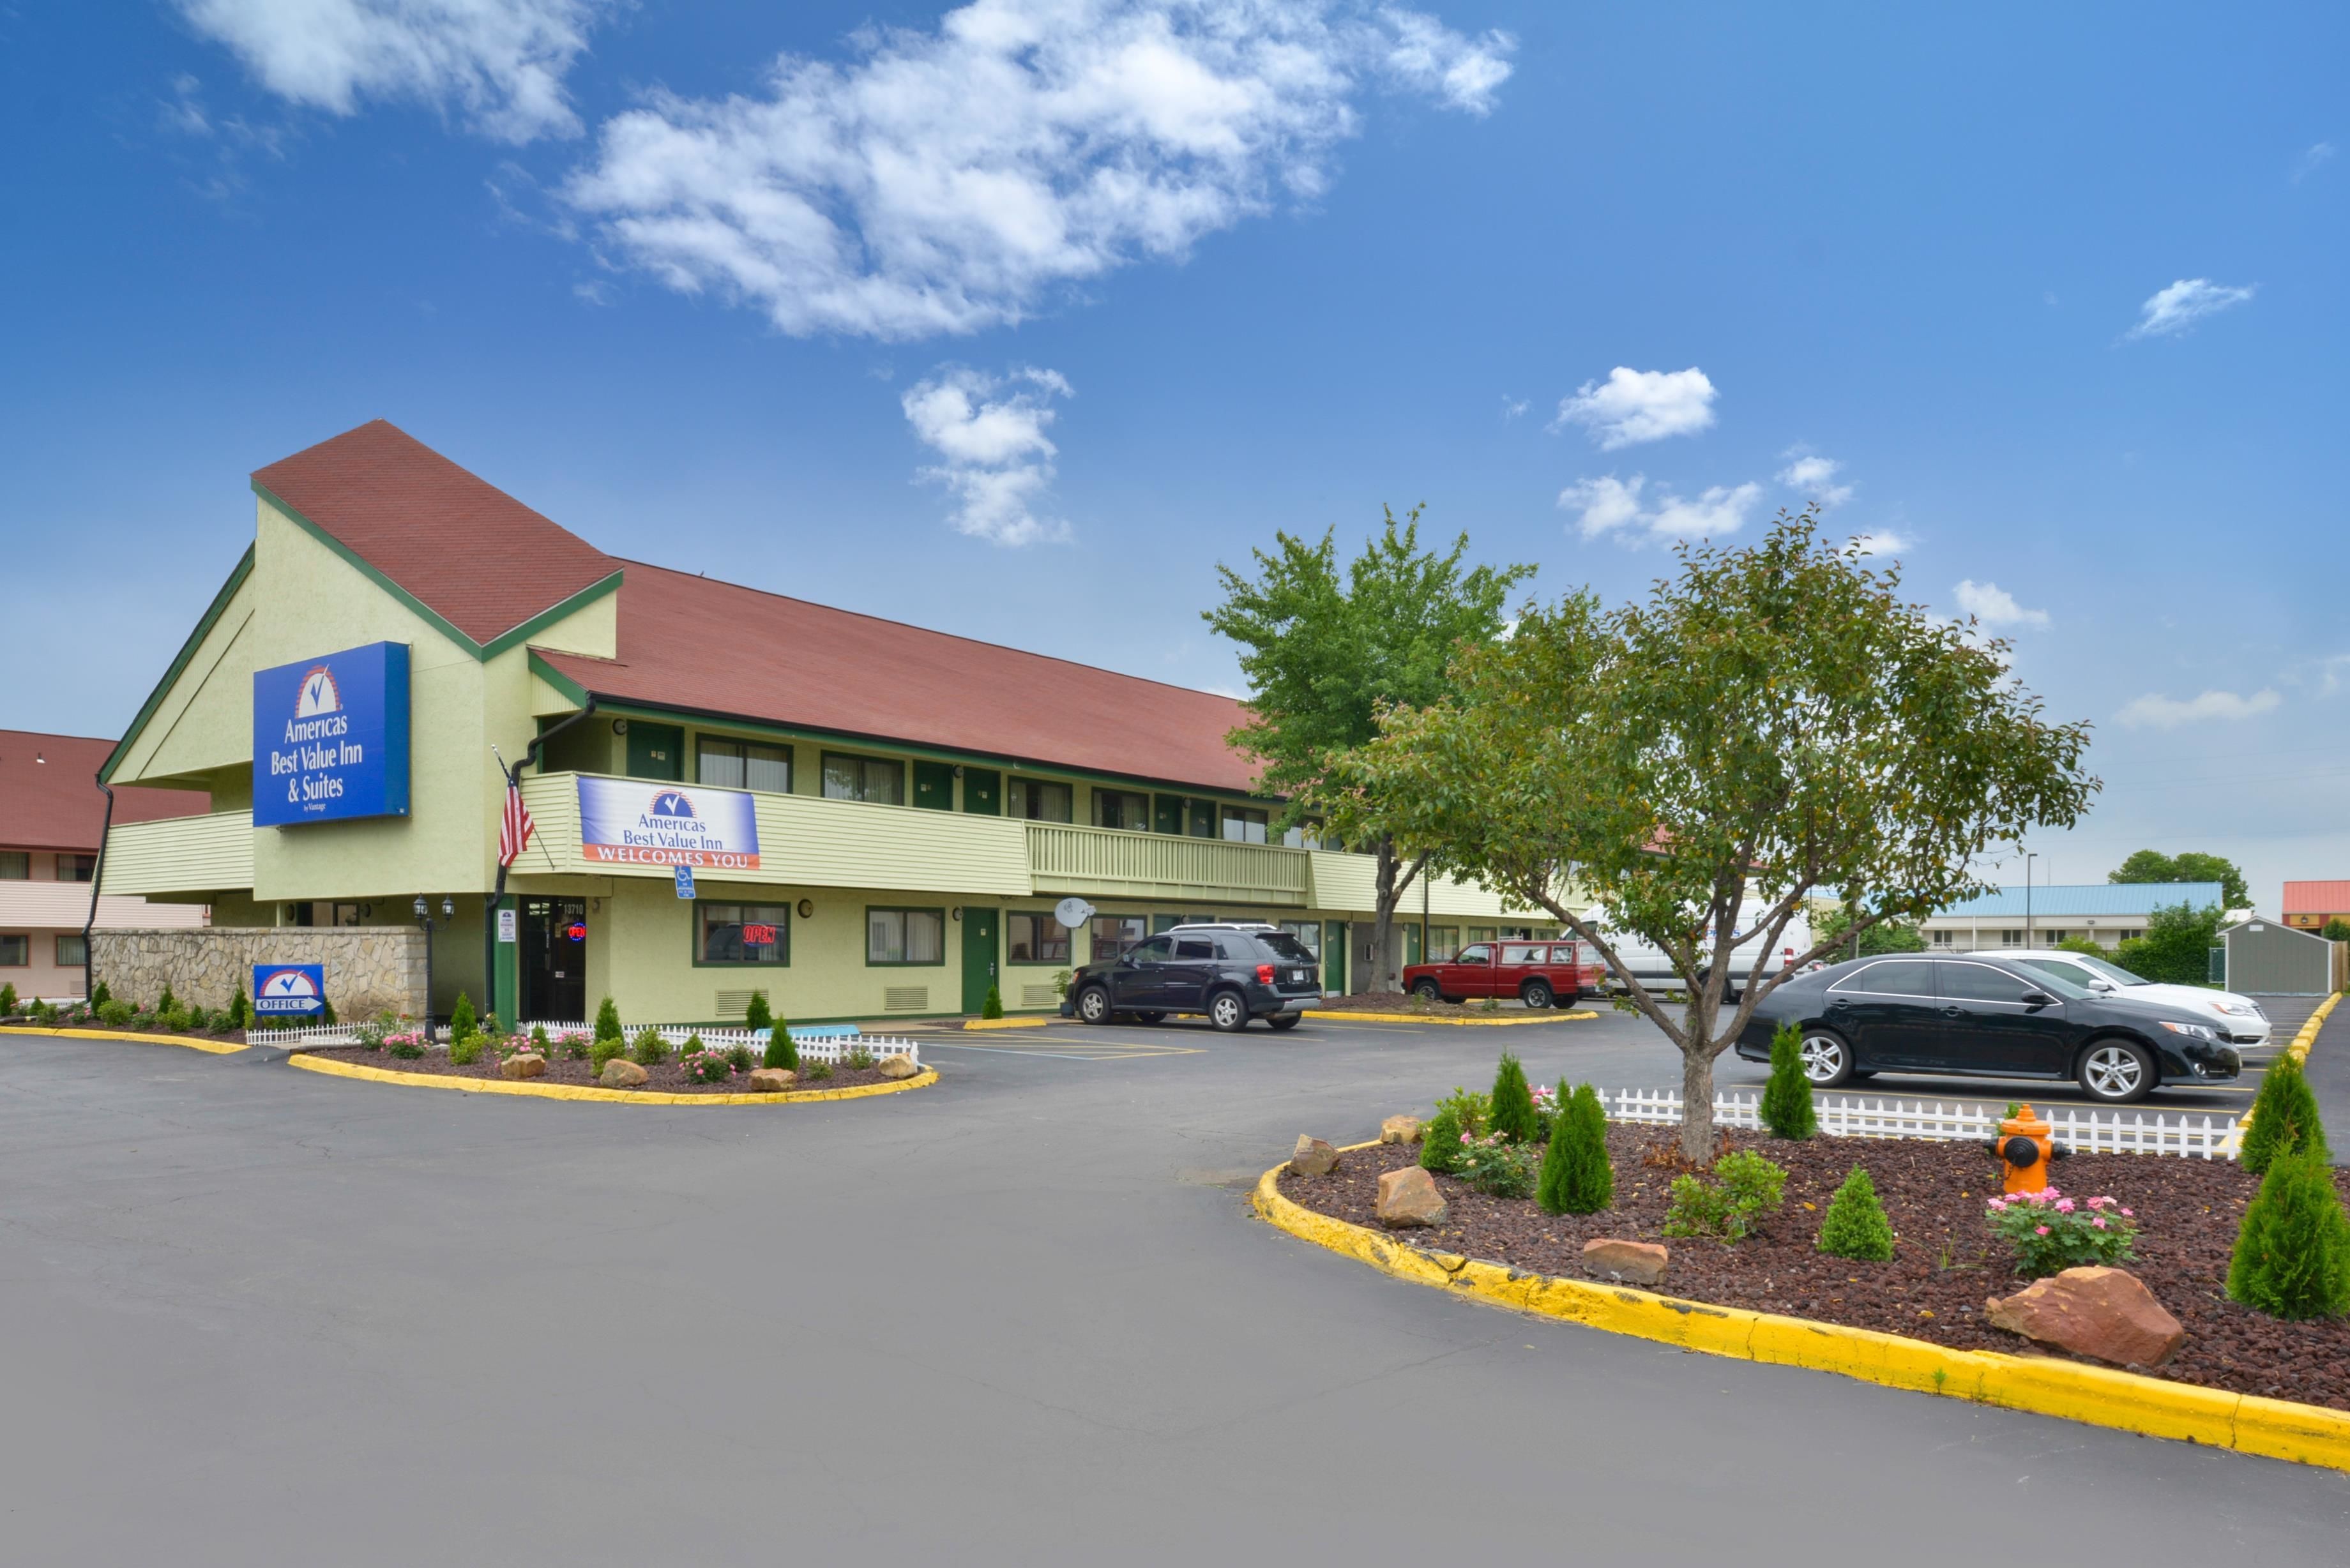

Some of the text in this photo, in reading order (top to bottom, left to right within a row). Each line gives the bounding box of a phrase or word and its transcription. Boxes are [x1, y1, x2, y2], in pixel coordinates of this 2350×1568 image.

[284, 715, 347, 744] Americas
[271, 741, 362, 775] Best Value Inn
[288, 772, 343, 803] & Suites
[308, 803, 326, 811] Vantage
[639, 813, 706, 832] Americas
[623, 830, 723, 850] Best Value Inn
[597, 847, 748, 868] WELCOMES YOU
[564, 904, 584, 914] 13710
[568, 926, 586, 938] OPEN
[743, 925, 777, 944] OPEN
[260, 1000, 305, 1009] OFFICE
